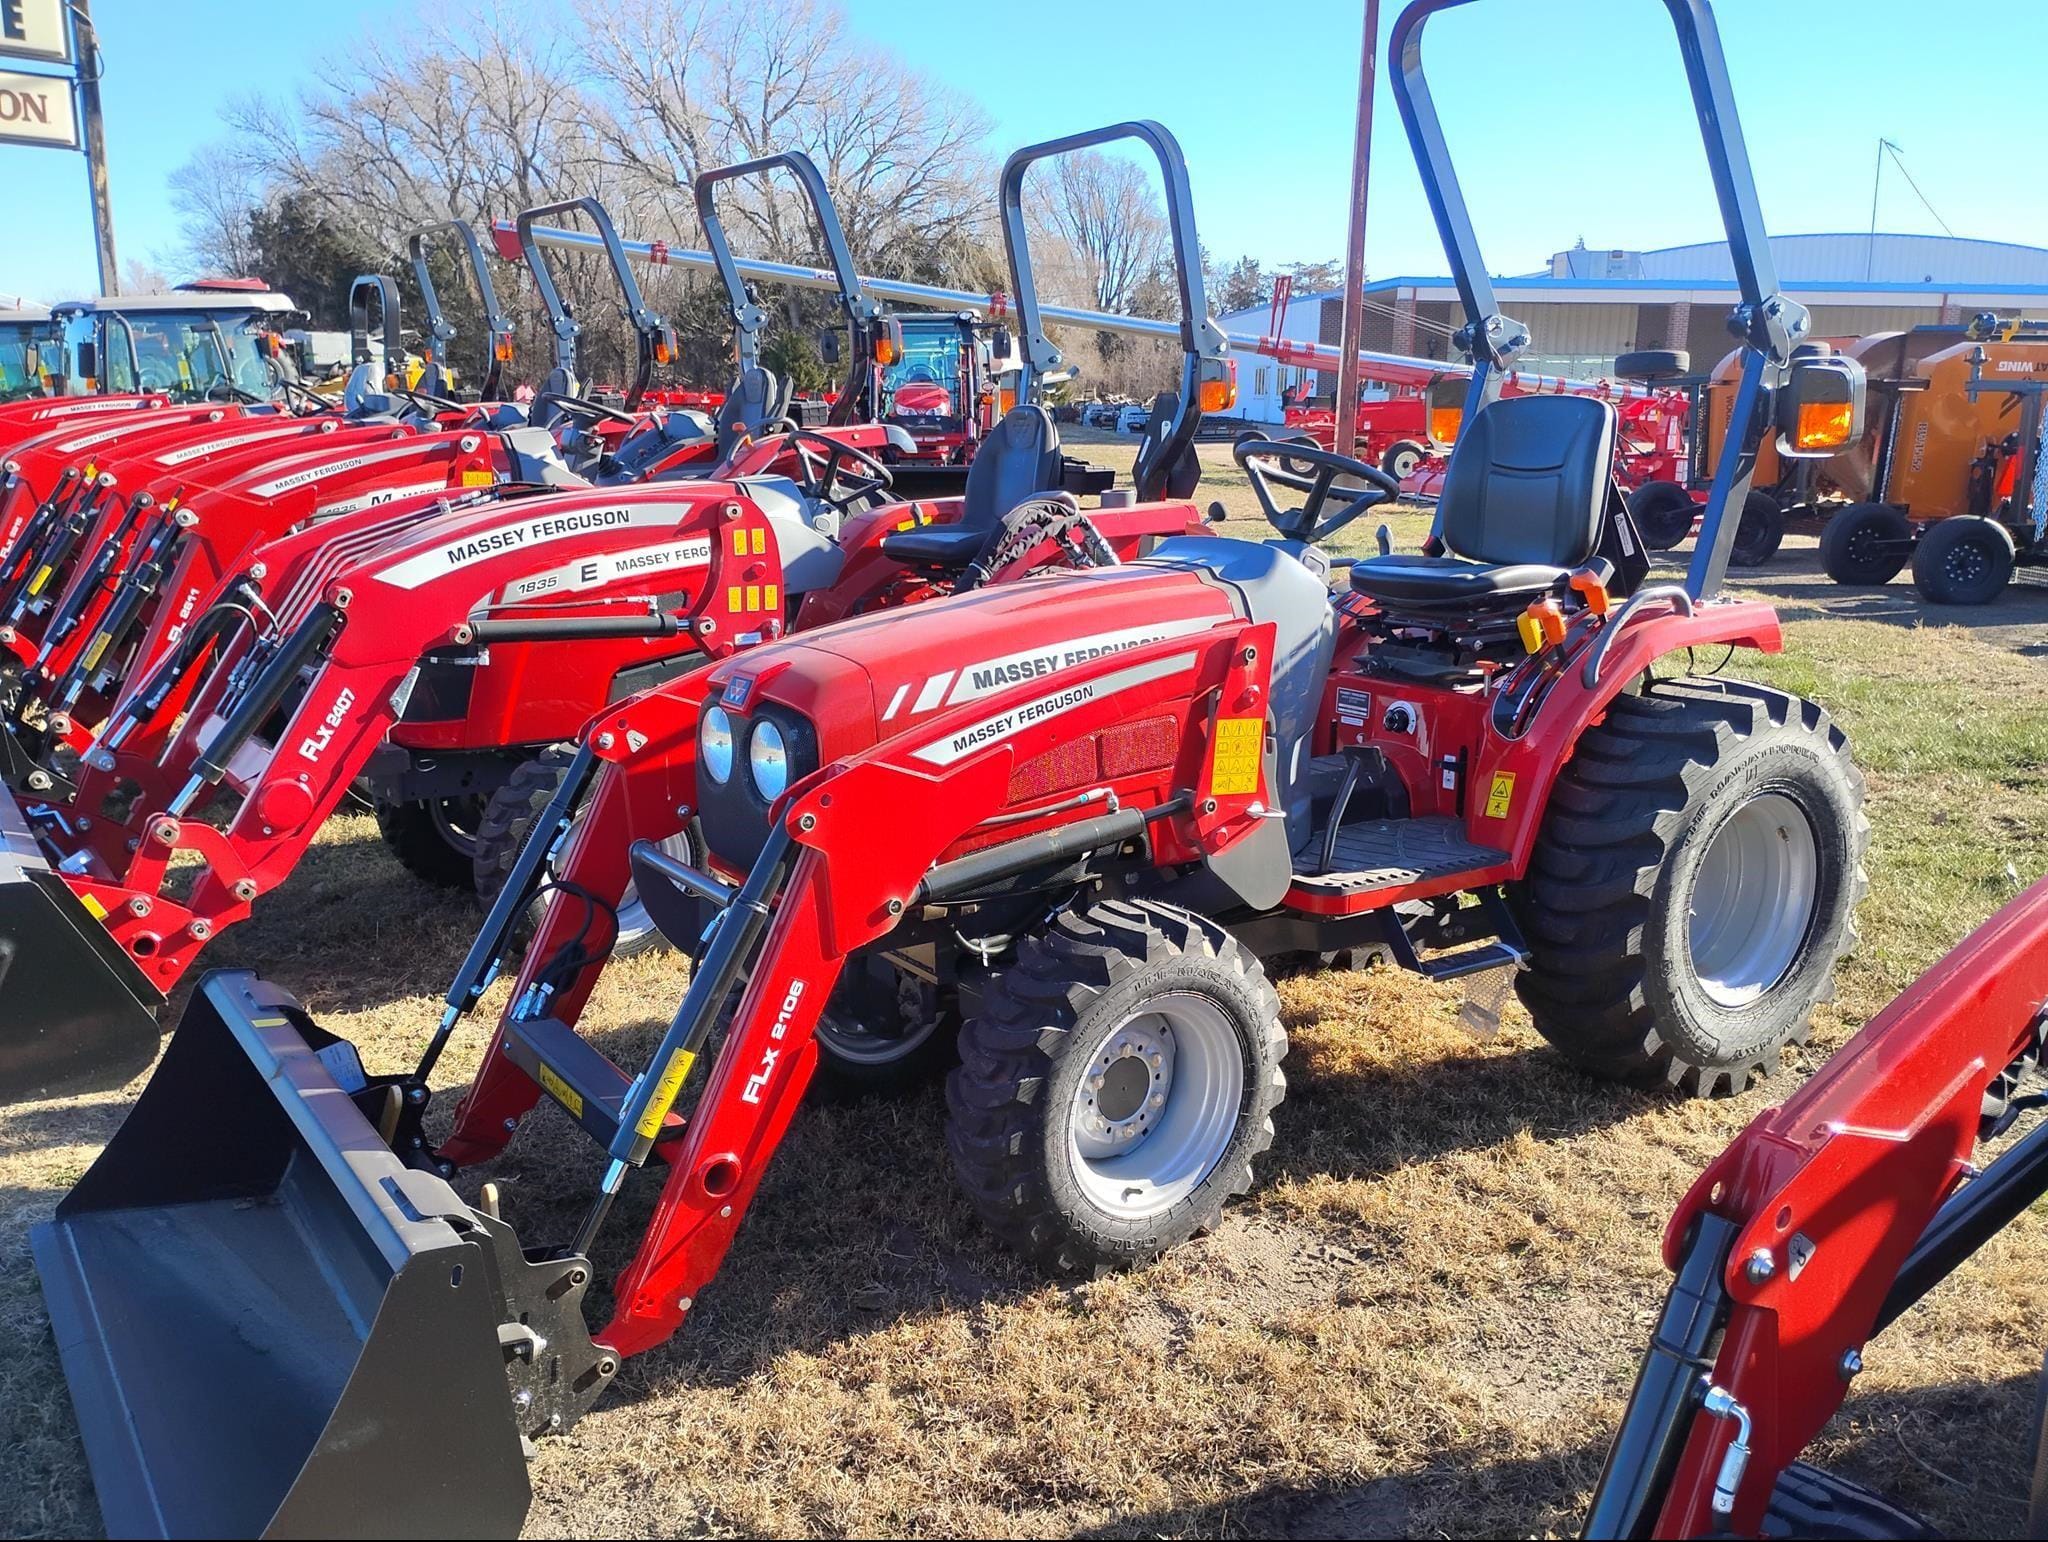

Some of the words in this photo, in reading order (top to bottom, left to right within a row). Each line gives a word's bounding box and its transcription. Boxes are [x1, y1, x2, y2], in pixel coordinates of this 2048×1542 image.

[0, 89, 48, 124] ON
[176, 446, 205, 459] MASSEY
[207, 437, 245, 450] FERGUSON
[275, 472, 312, 490] MASSEY
[314, 458, 362, 478] FERGUSON
[447, 528, 526, 564] MASSEY
[532, 509, 630, 538] FERGUSON
[518, 576, 557, 594] 1835
[580, 562, 598, 583] E
[616, 551, 670, 573] MASSEY
[972, 655, 1058, 690] MASSEY
[298, 723, 336, 763] FLX
[325, 687, 356, 728] 2407
[953, 716, 1013, 752] MASSEY
[1018, 685, 1094, 724] FERGUSON
[741, 1046, 780, 1105] FLX
[770, 979, 804, 1041] 2106
